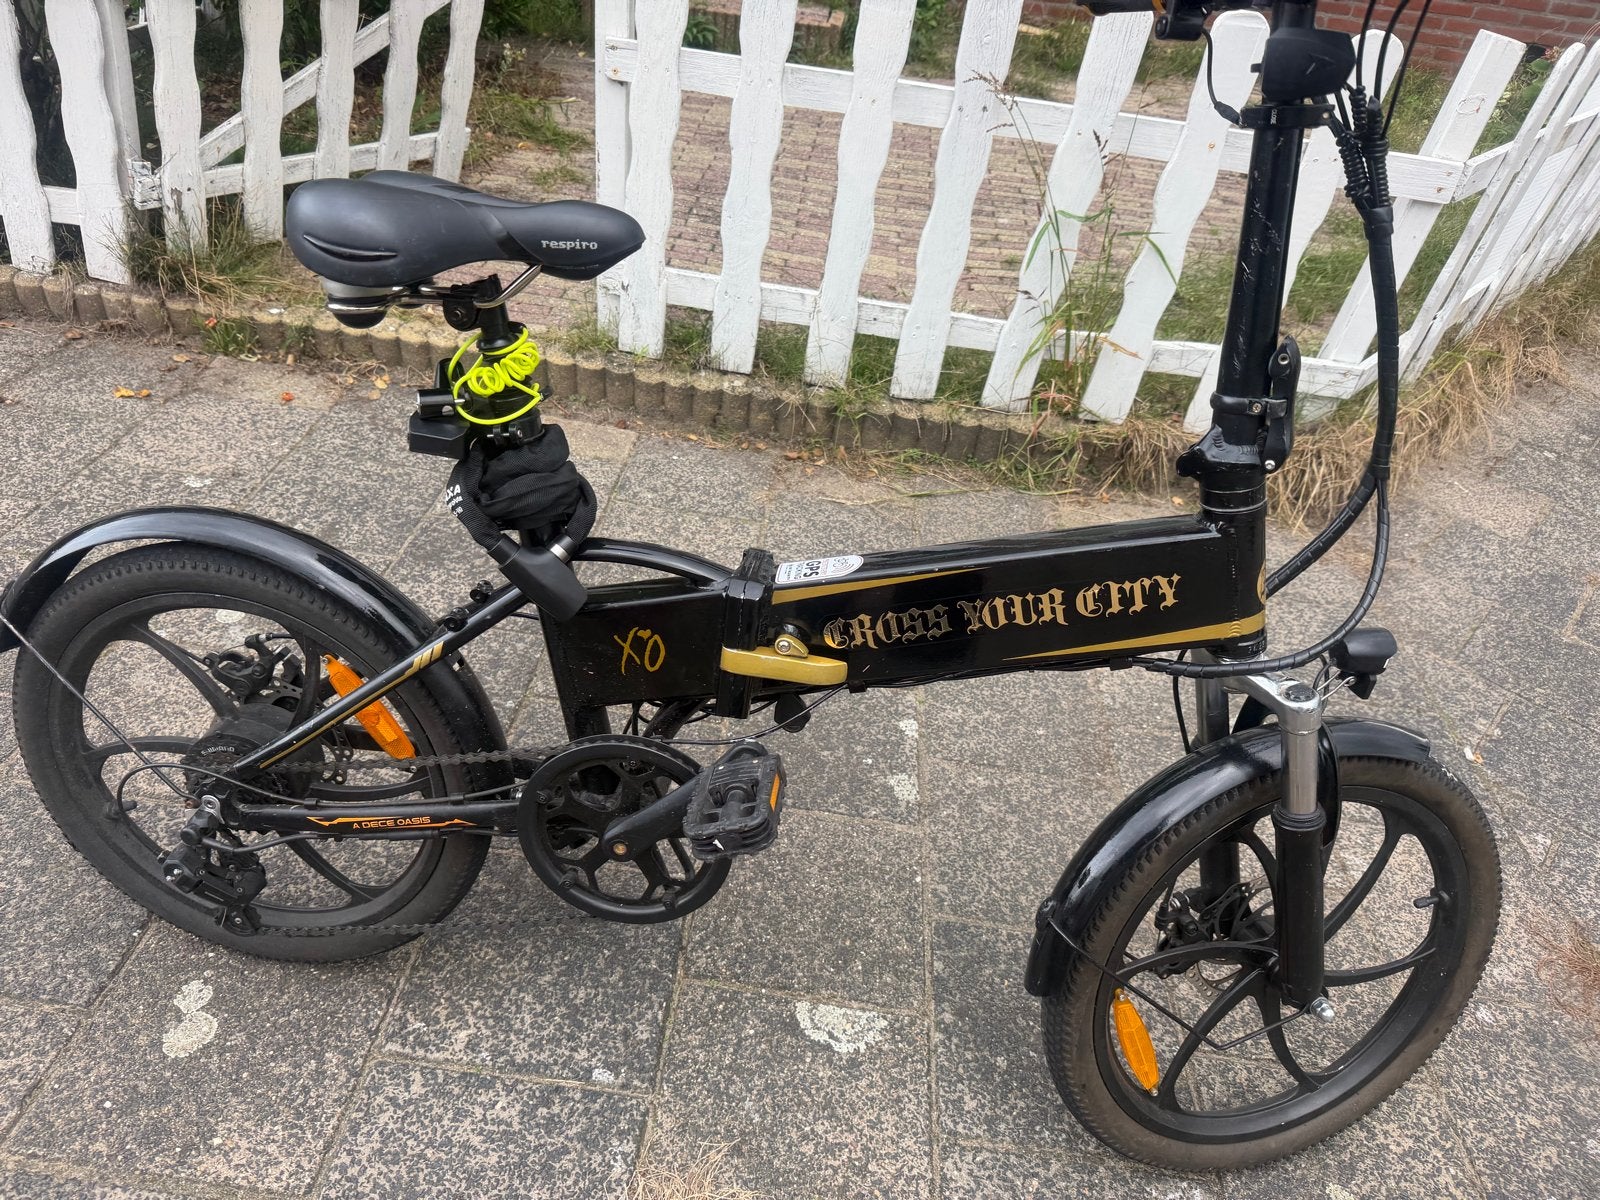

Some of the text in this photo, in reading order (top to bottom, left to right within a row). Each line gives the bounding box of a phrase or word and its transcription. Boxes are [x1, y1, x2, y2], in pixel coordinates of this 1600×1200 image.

[541, 239, 598, 250] respiro
[803, 561, 822, 578] GPS
[823, 572, 1182, 650] CROSS YOUR CITY
[362, 819, 395, 829] DECE
[396, 816, 431, 826] OASIS
